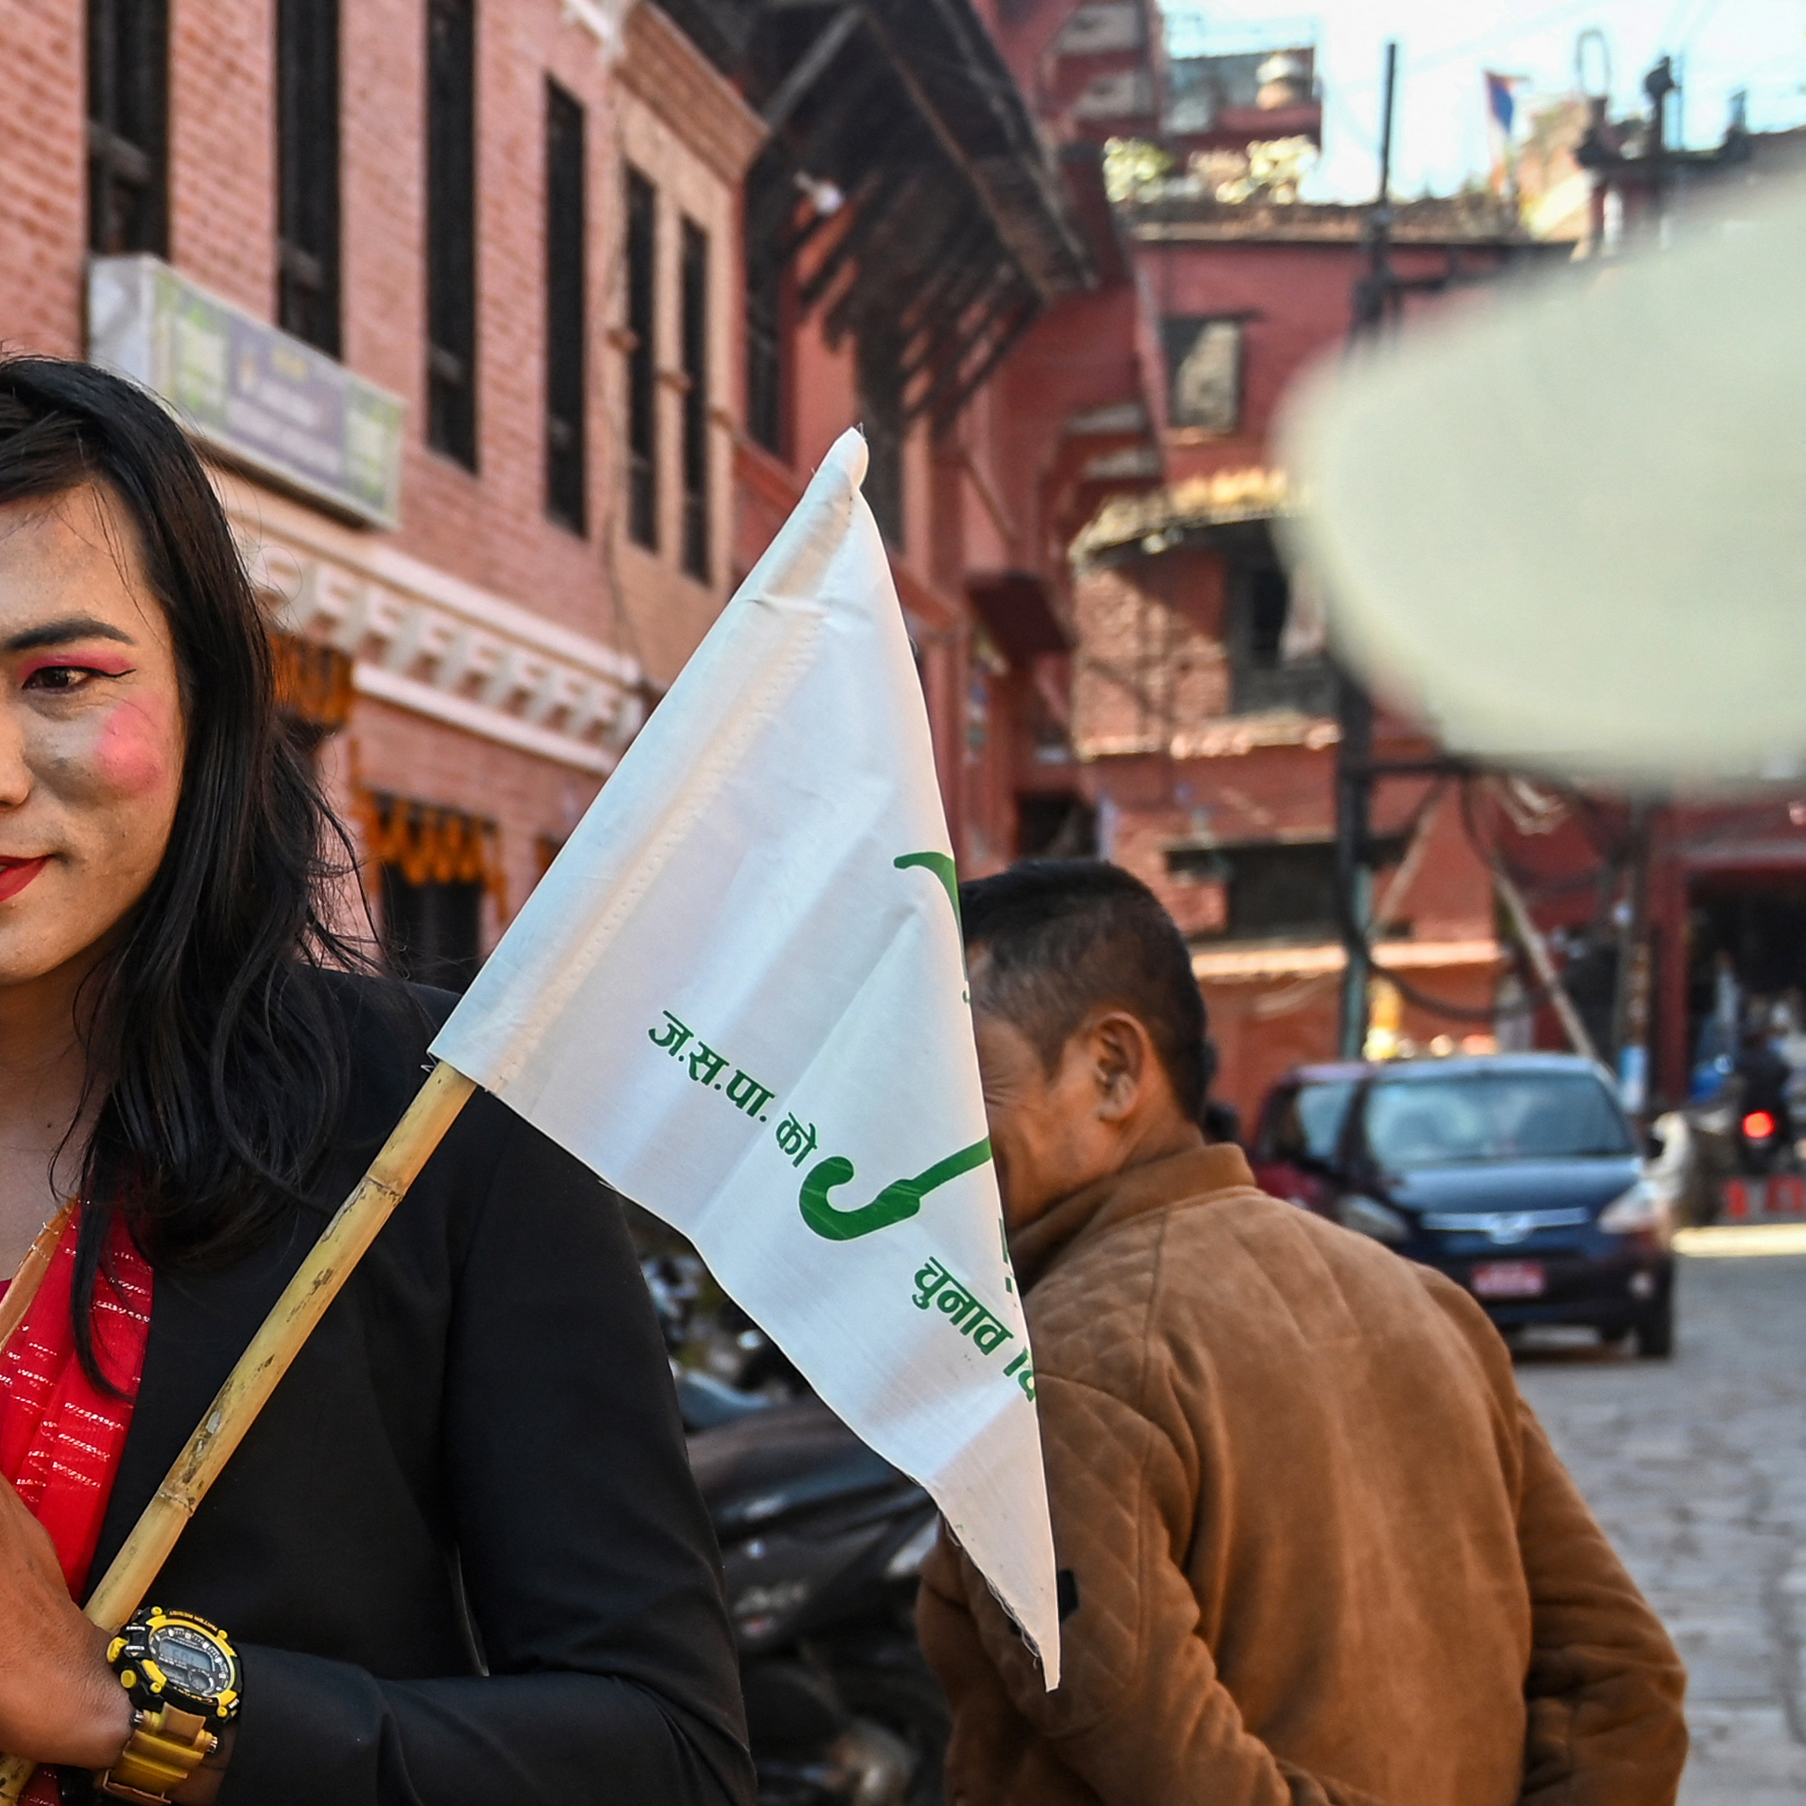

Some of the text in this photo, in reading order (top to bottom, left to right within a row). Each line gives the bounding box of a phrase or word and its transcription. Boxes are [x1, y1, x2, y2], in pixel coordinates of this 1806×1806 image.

[648, 1010, 819, 1168] ज.स.पा. को
[911, 1256, 1014, 1356] चुनाव
